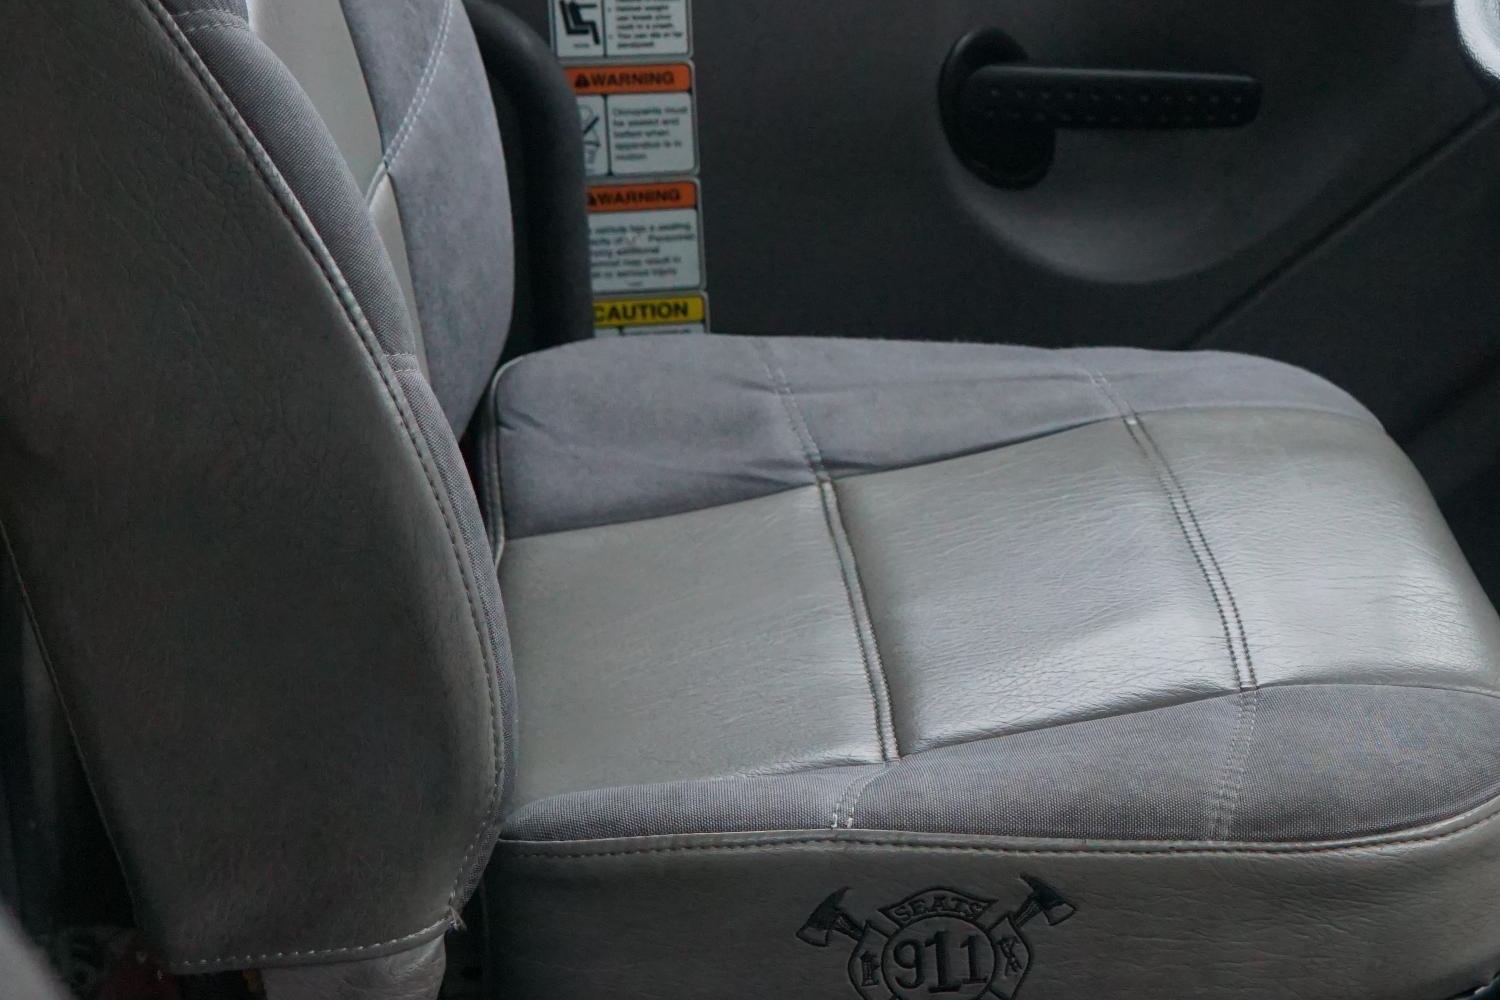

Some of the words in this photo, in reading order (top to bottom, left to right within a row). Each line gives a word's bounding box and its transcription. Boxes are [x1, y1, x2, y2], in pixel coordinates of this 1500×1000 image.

[591, 71, 675, 87] WARNING
[598, 189, 681, 206] WARNING
[594, 300, 689, 323] CAUTION
[894, 894, 986, 921] SEATS
[892, 929, 989, 993] 911
